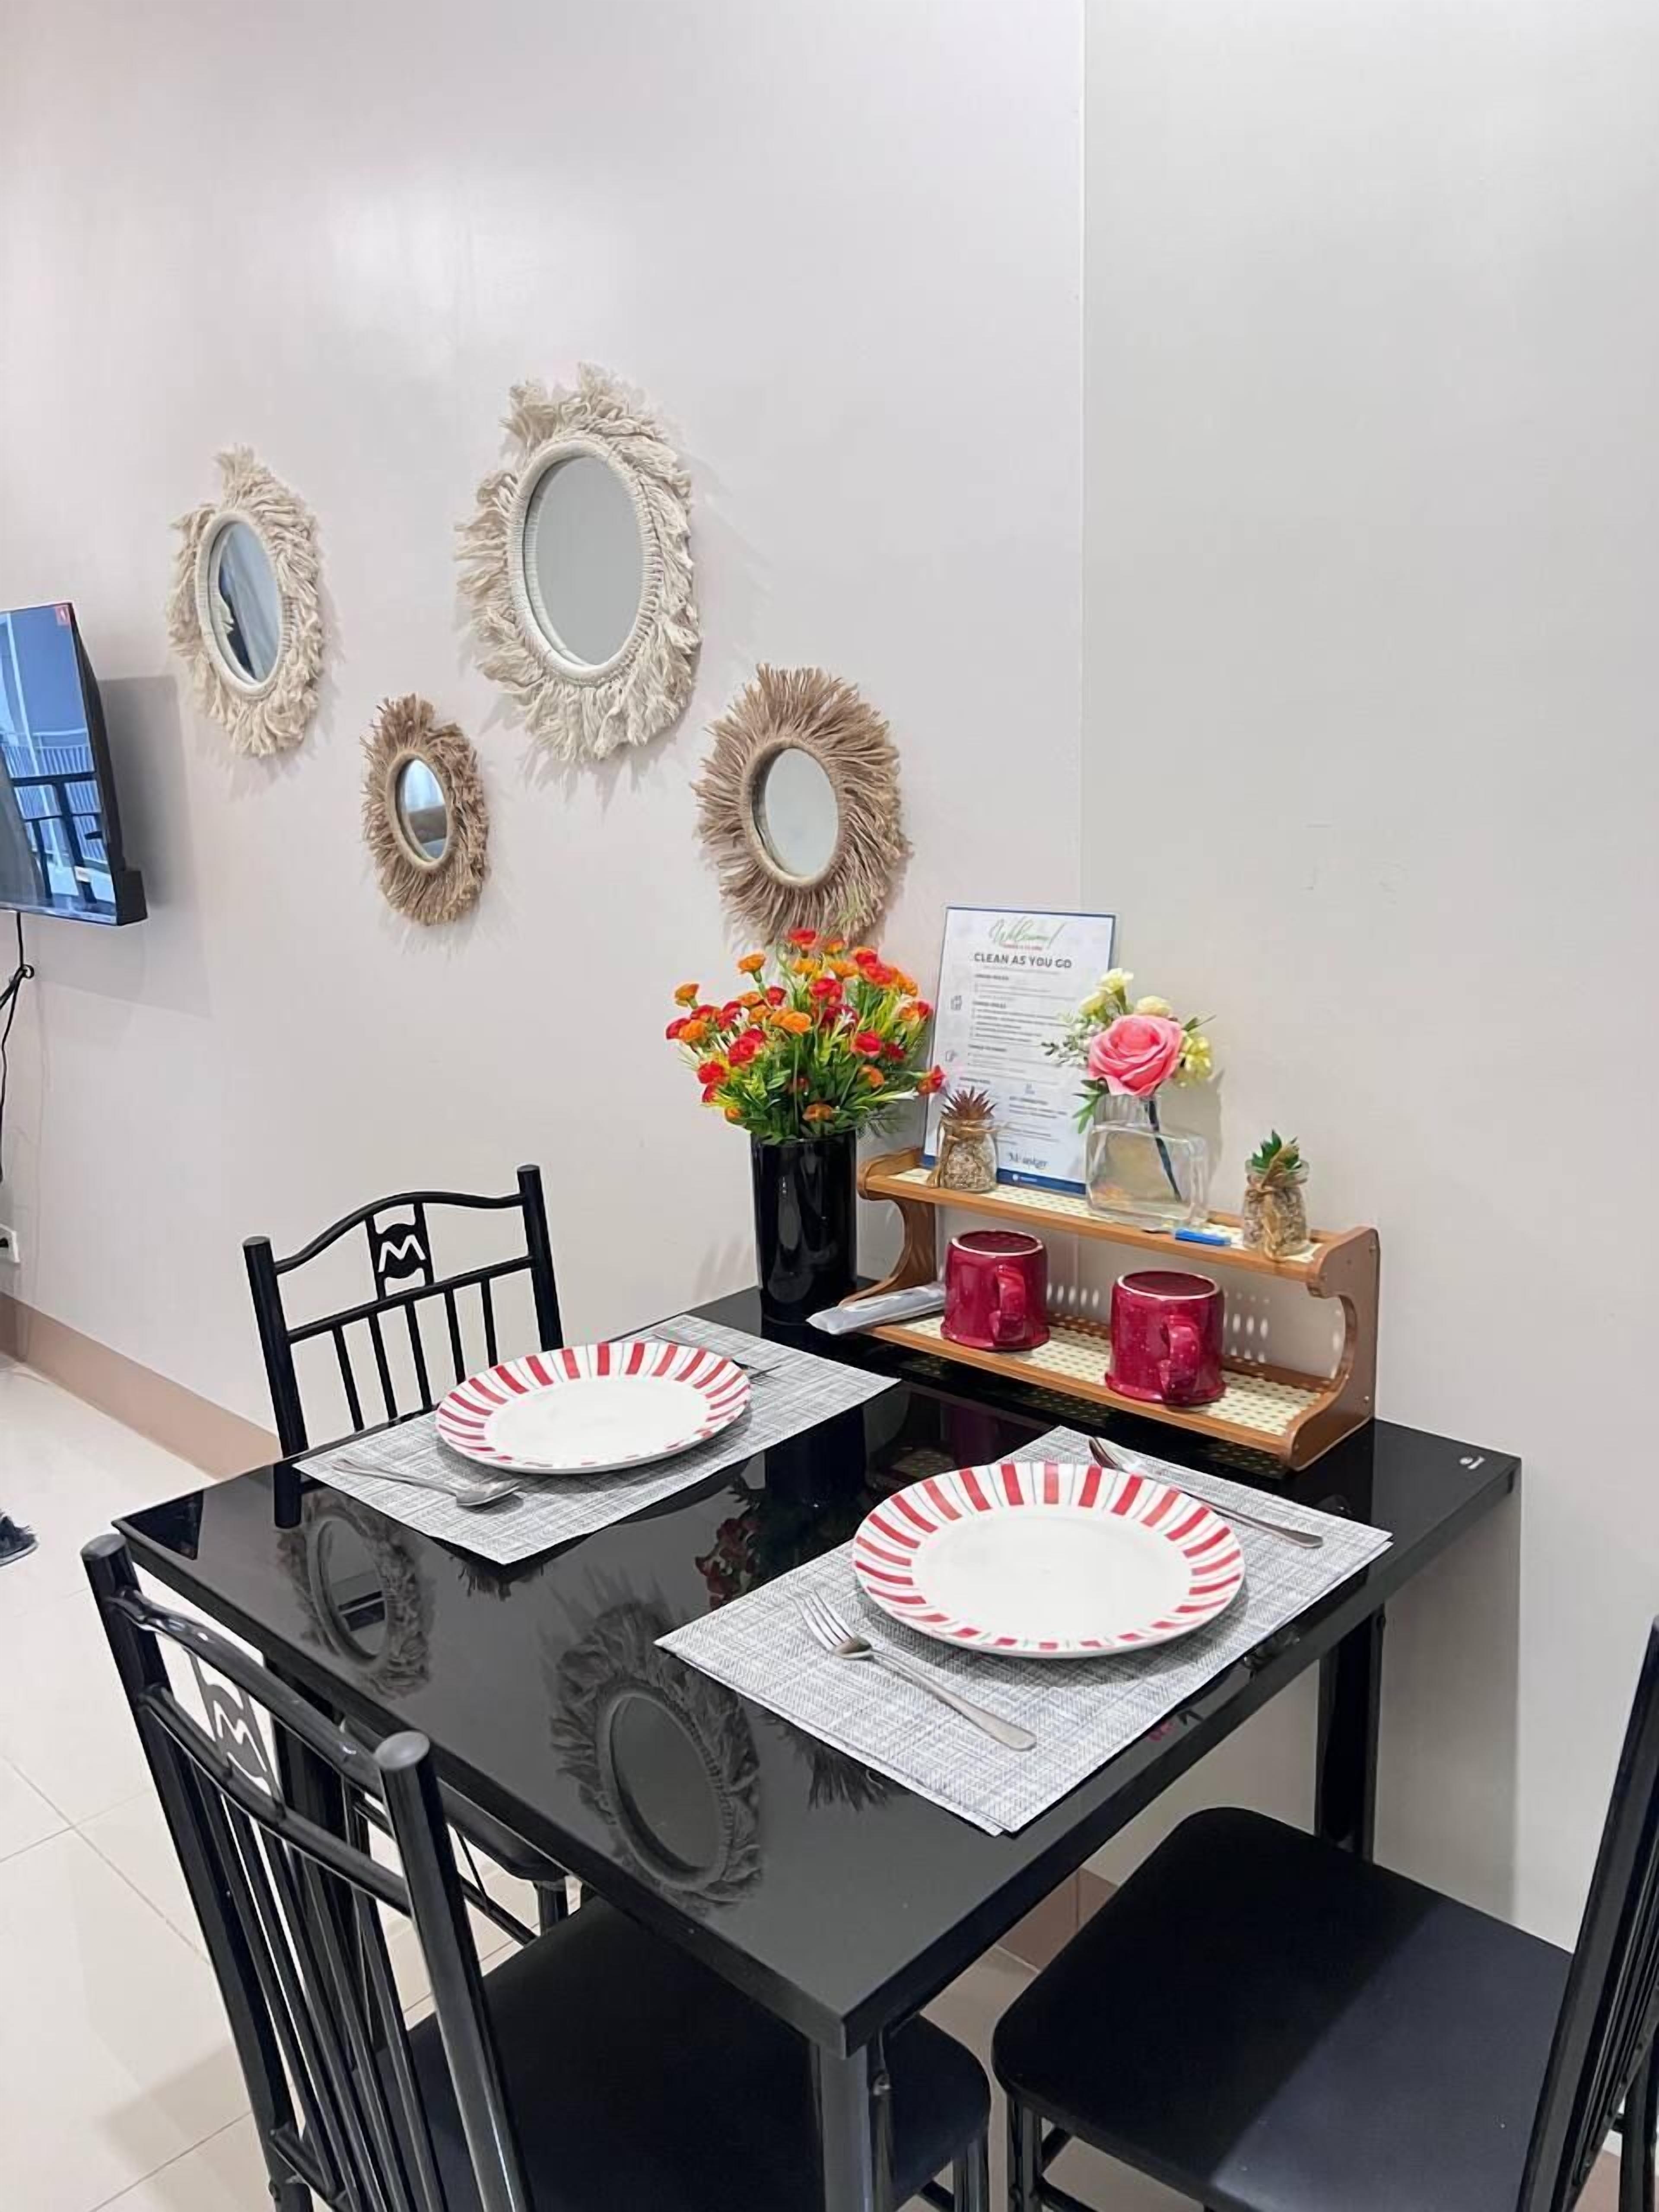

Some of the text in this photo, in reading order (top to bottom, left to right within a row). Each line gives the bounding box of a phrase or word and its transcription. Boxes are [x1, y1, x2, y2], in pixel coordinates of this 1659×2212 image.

[974, 952, 1072, 968] CLEAN AS YOU GO
